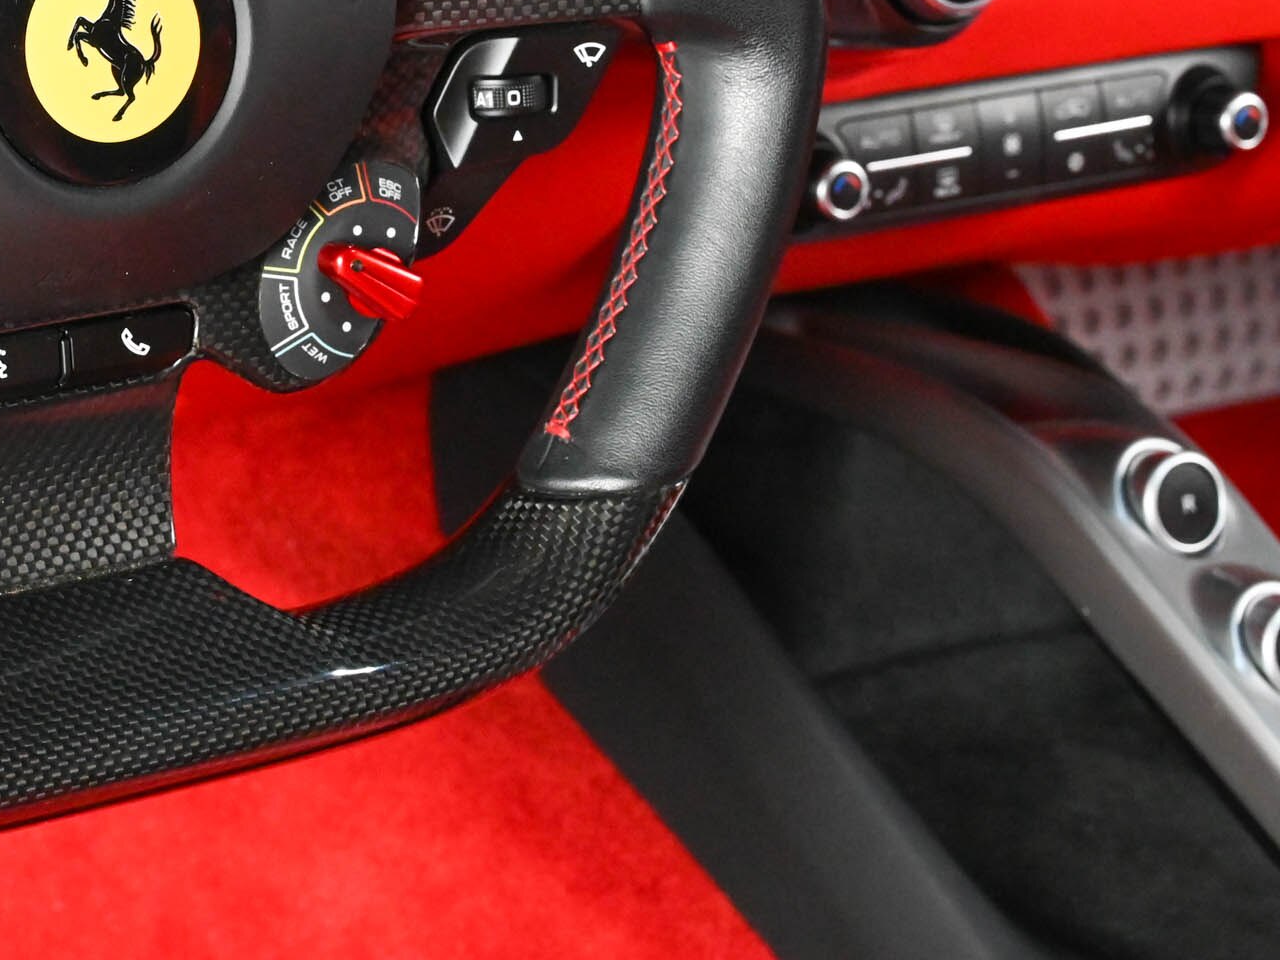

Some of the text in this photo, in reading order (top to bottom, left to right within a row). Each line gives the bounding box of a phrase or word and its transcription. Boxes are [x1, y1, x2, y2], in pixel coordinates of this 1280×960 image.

[328, 186, 353, 203] OFF
[378, 177, 402, 193] ESC
[378, 187, 402, 201] OFF
[281, 218, 308, 260] RACE
[279, 283, 299, 331] SPORT
[301, 343, 328, 364] WET
